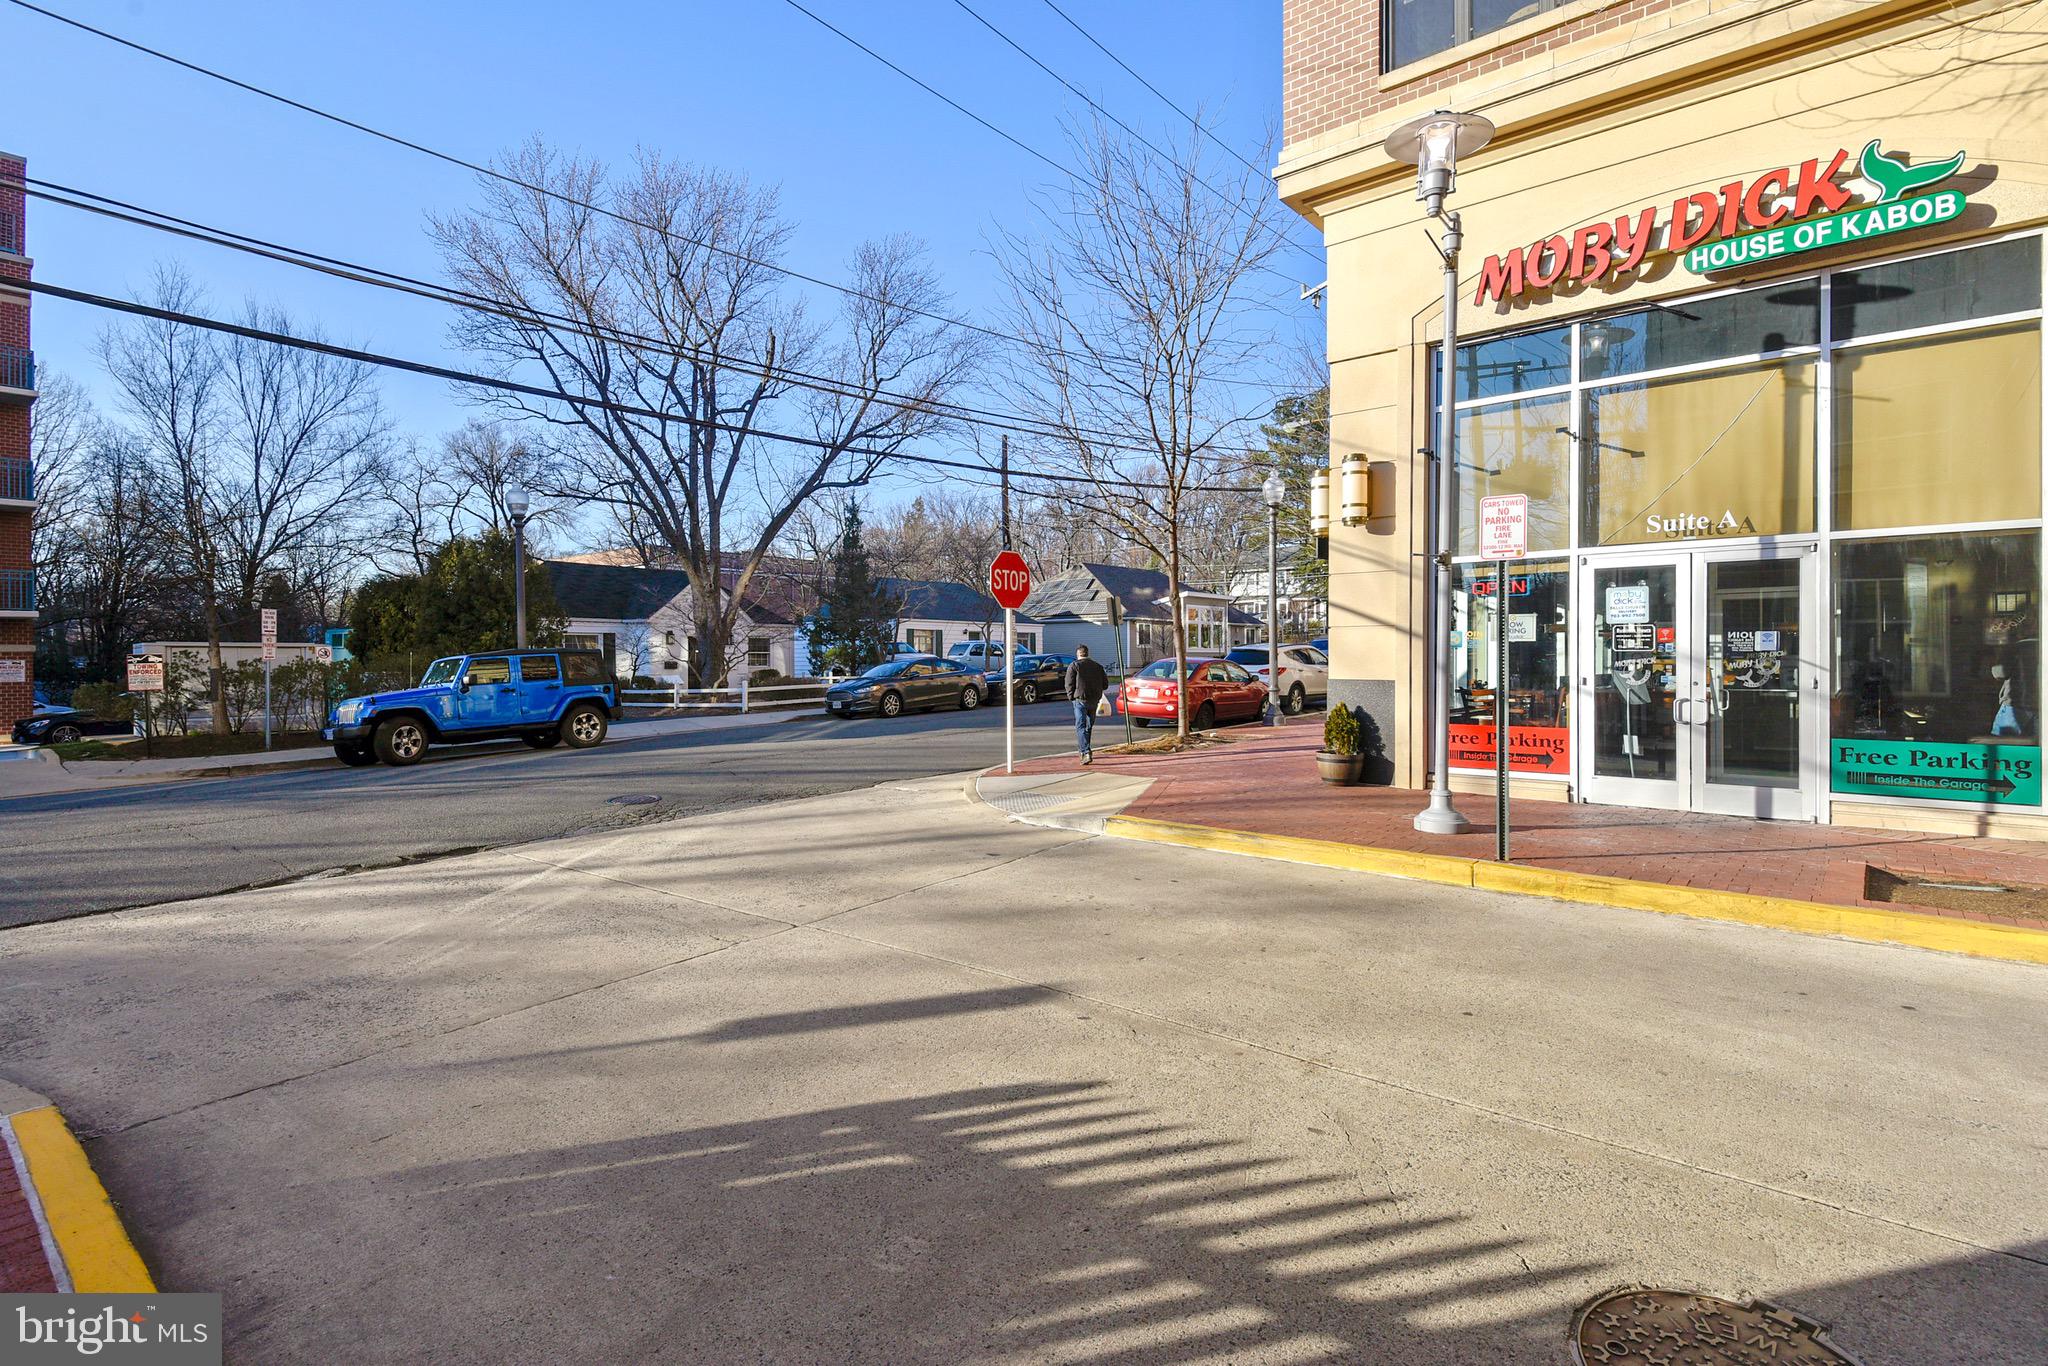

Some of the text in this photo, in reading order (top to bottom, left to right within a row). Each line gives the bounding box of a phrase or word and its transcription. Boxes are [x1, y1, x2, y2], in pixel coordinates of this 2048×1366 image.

[1474, 148, 1852, 307] MOBY DICK
[1691, 193, 1957, 271] HOUSE OF KABOB
[1485, 515, 1521, 524] PARKING
[1497, 507, 1509, 515] NO
[1646, 509, 1738, 533] Suite A
[993, 568, 1028, 592] STOP
[1472, 580, 1526, 595] OPN
[1449, 731, 1565, 754] ree Prking
[1839, 746, 2033, 780] Free Parking
[1874, 774, 1996, 791] Inside The Garage
